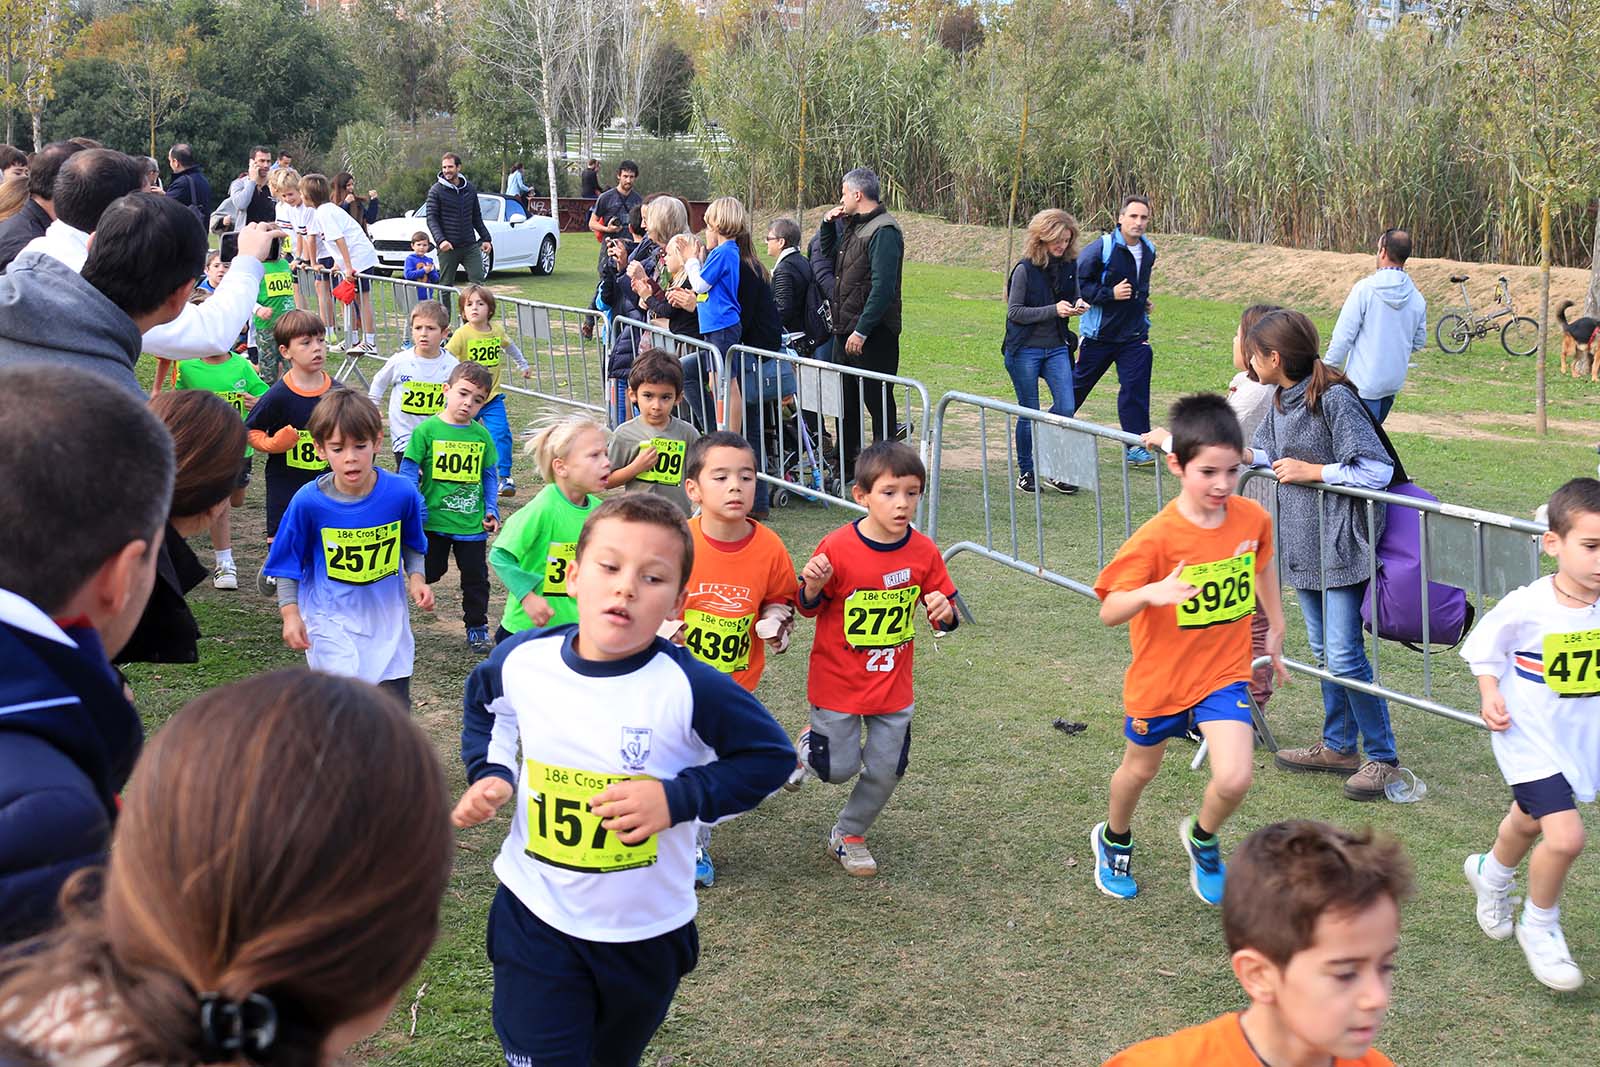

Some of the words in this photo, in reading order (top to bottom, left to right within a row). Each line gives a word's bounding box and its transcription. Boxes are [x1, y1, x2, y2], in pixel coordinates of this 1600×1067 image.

[403, 390, 445, 408] 2314
[435, 453, 481, 475] 4041
[337, 529, 354, 539] 18è
[356, 529, 375, 539] Cros
[327, 536, 397, 573] 2577
[863, 592, 879, 601] 18è
[881, 591, 900, 601] Cros
[1181, 571, 1250, 614] 3926
[718, 618, 737, 628] Cros
[847, 601, 912, 635] 2721
[686, 626, 750, 663] 4398
[865, 648, 895, 672] 23
[544, 767, 570, 785] 18è
[574, 772, 605, 790] Cros
[533, 792, 652, 850] 157
